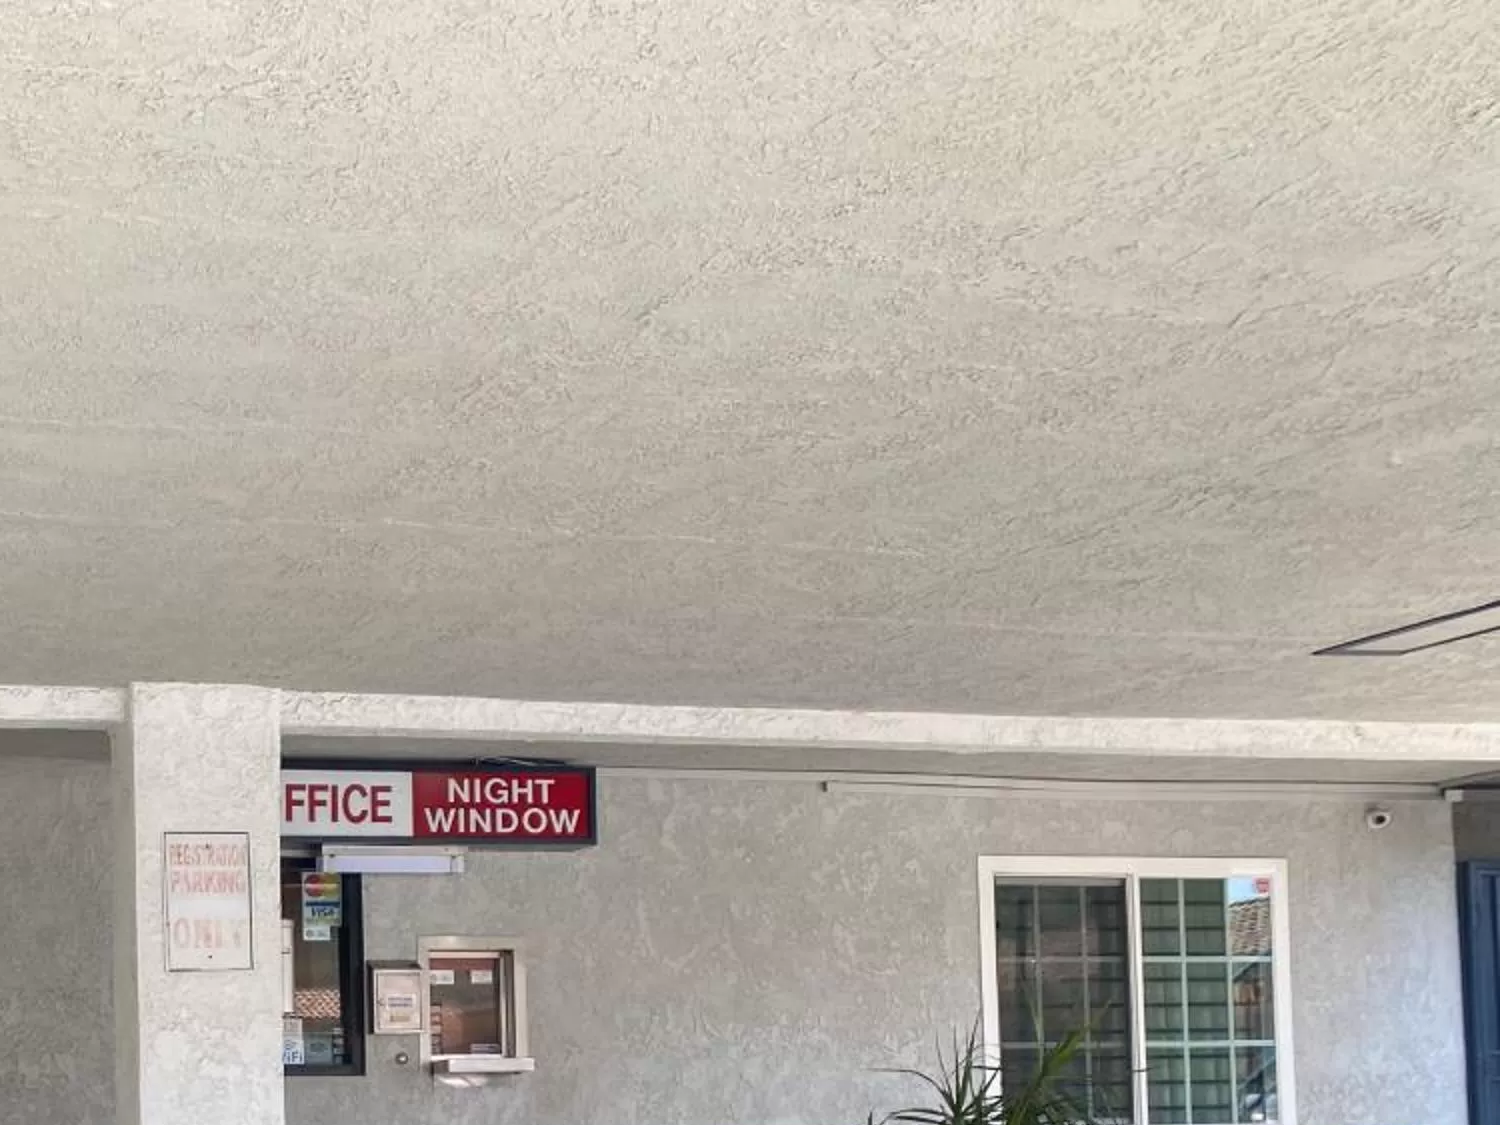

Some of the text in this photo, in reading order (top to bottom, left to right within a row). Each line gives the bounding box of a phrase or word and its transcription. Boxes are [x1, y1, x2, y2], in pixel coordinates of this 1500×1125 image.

[285, 783, 393, 824] FFICE
[448, 777, 555, 804] NIGHT
[423, 807, 581, 834] WINDOW
[171, 871, 247, 893] PARKING
